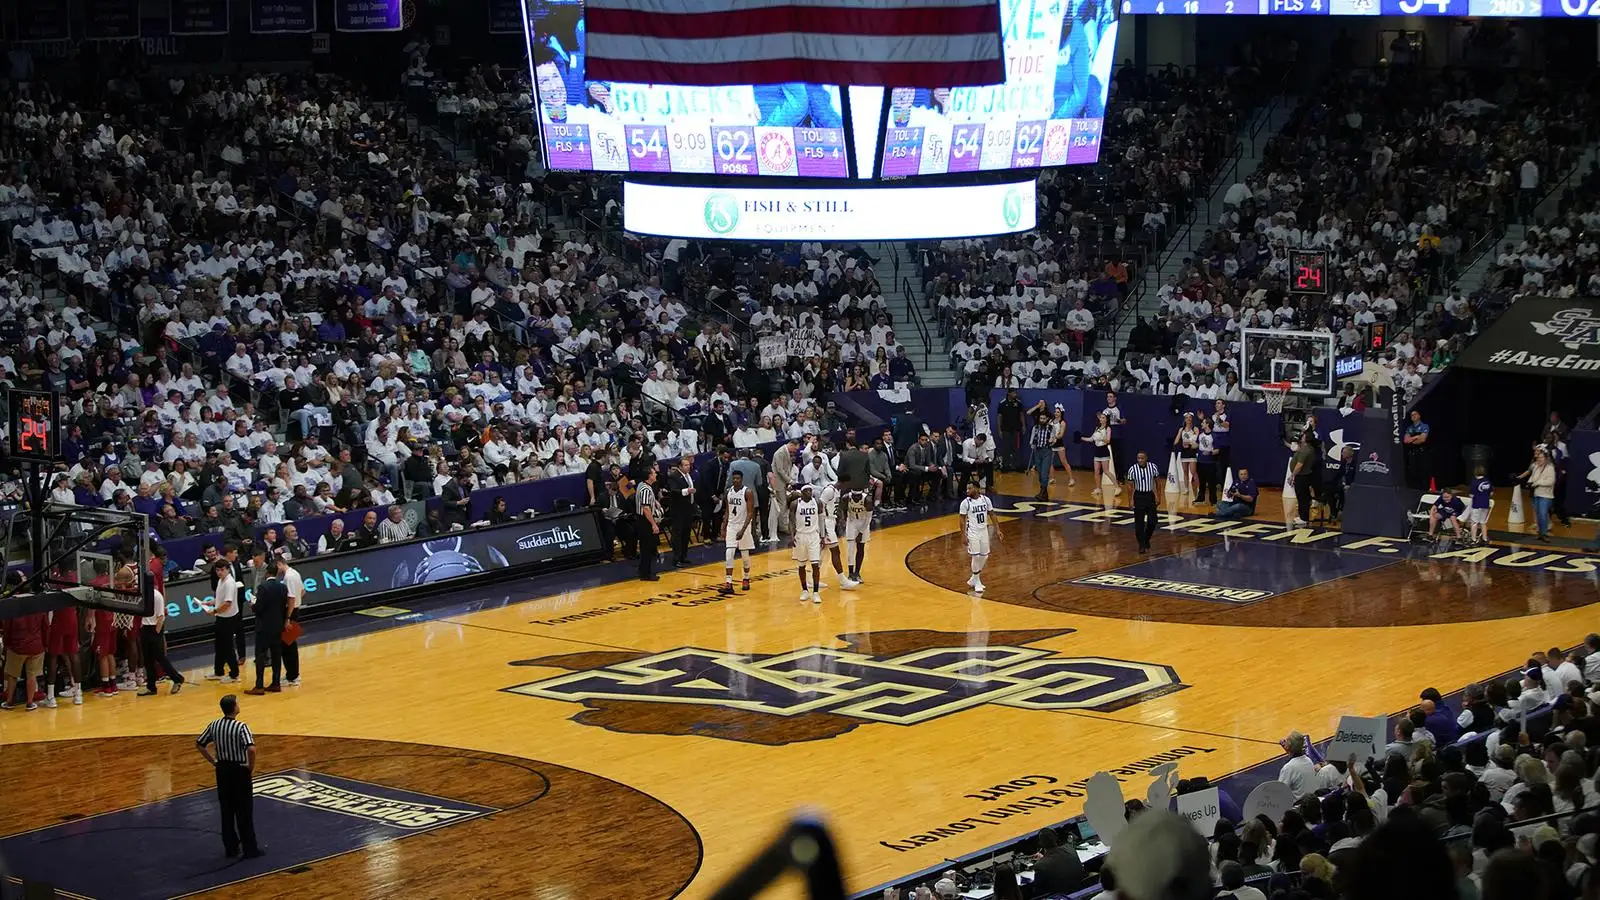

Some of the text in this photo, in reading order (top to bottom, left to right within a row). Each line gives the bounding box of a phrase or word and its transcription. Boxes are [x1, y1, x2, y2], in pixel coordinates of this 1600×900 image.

[1155, 1, 1165, 14] 4
[1184, 0, 1199, 14] 16
[1224, 0, 1235, 14] 2
[1273, 0, 1322, 12] FLS 4
[1008, 55, 1045, 75] TIDE
[615, 88, 743, 116] GO JACKS
[952, 85, 1046, 113] GO JACKS
[553, 126, 583, 137] TOL 2
[1075, 120, 1099, 132] TOL 3
[673, 133, 706, 151] 9:09
[802, 130, 838, 142] TOL 3
[894, 128, 920, 141] TOL 2
[1016, 124, 1041, 155] 62
[1073, 135, 1097, 147] FLS 4
[555, 141, 585, 153] FLS 4
[631, 128, 664, 160] 54
[716, 130, 752, 161] 62
[953, 127, 980, 159] 54
[804, 148, 839, 159] FLS 4
[892, 145, 917, 158] FLS 4
[722, 163, 749, 174] POSS
[744, 200, 854, 213] FISH & STILL
[756, 223, 836, 234] EQUIPMENT
[1297, 266, 1320, 289] 24
[1335, 357, 1363, 376] #AxeEm
[1488, 349, 1600, 370] #AxeEm
[1391, 393, 1400, 444] #AxeEm
[21, 417, 47, 451] 24
[1326, 462, 1341, 470] UND
[729, 498, 742, 506] JACKS
[972, 504, 987, 514] JACKS
[732, 505, 738, 517] 4
[799, 507, 816, 516] JACKS
[976, 513, 985, 524] 10
[804, 516, 811, 527] 5
[988, 501, 1343, 544] STEPHEN
[1340, 536, 1411, 553] F.
[518, 525, 581, 550] suddenlink
[322, 566, 370, 590] Net.
[1095, 574, 1266, 601] SOUTHLAND
[672, 591, 747, 607] Court
[528, 605, 629, 626] Tommie
[618, 596, 668, 608] Jan
[659, 591, 686, 600] &
[1335, 730, 1374, 745] Defense
[1109, 745, 1217, 776] Tommie
[963, 775, 1058, 802] Court
[252, 777, 442, 828] SOUTHLAND
[1203, 803, 1217, 818] Up
[879, 788, 1085, 852] & Elvin Lowery
